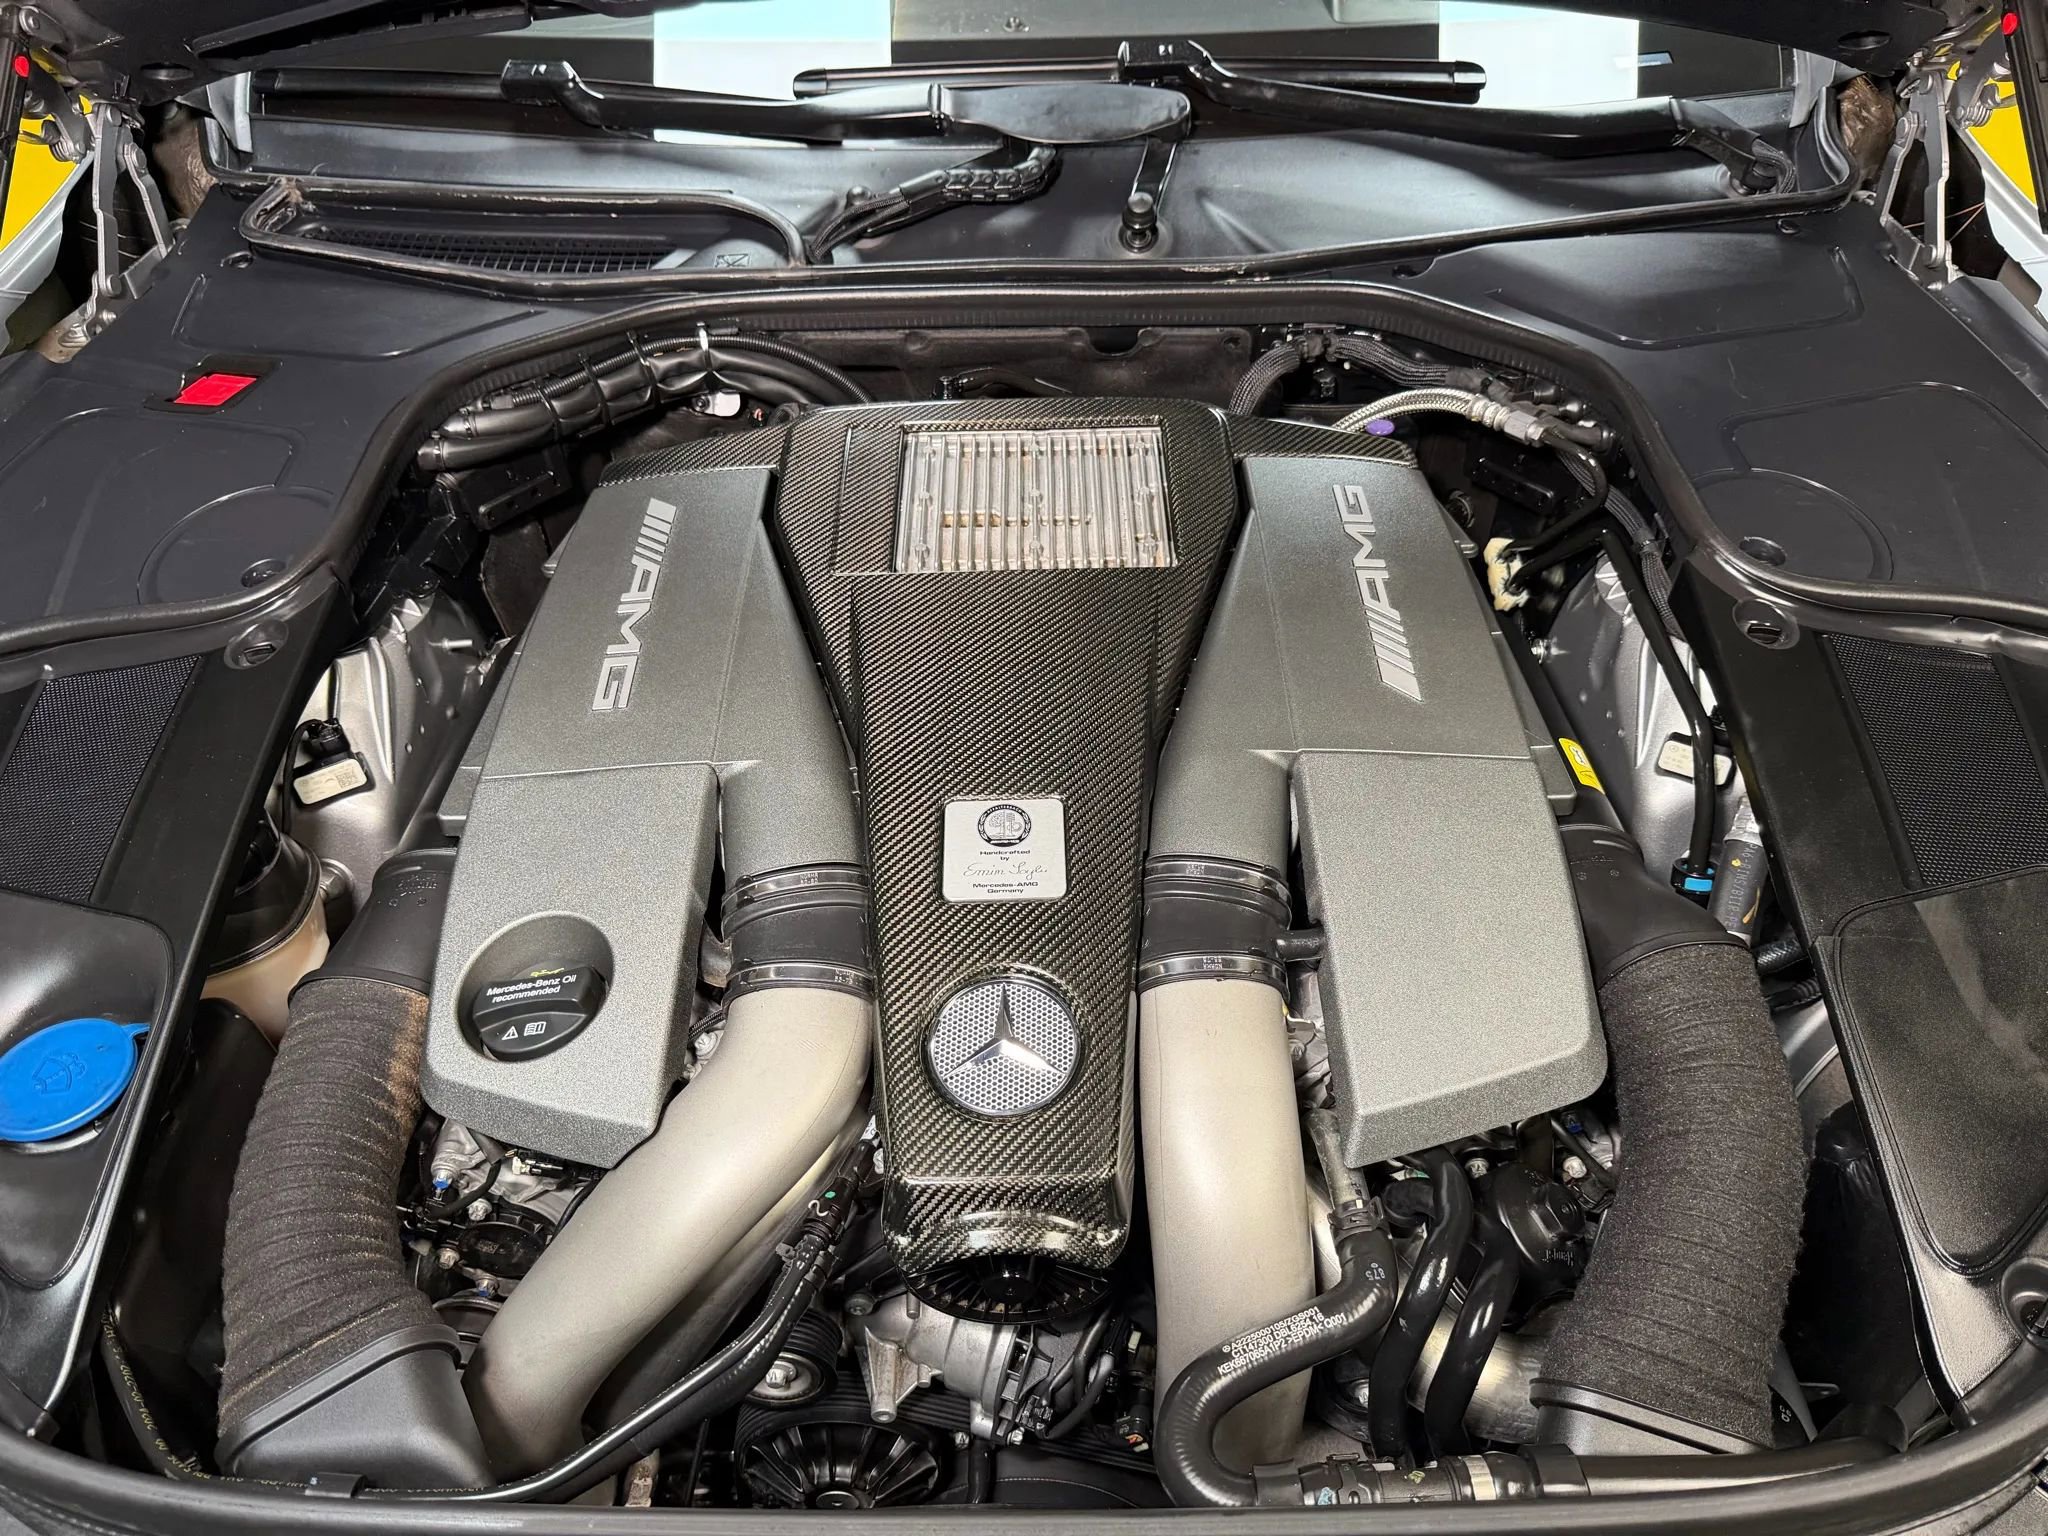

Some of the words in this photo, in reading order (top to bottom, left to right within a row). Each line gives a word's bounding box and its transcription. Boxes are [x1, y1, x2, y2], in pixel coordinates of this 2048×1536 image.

[972, 881, 1039, 889] Mercedes-AMG
[486, 978, 561, 996] Mercedes-Benz
[562, 974, 577, 984] Oil
[491, 985, 561, 1003] recommended
[1231, 1334, 1274, 1358] CT147300
